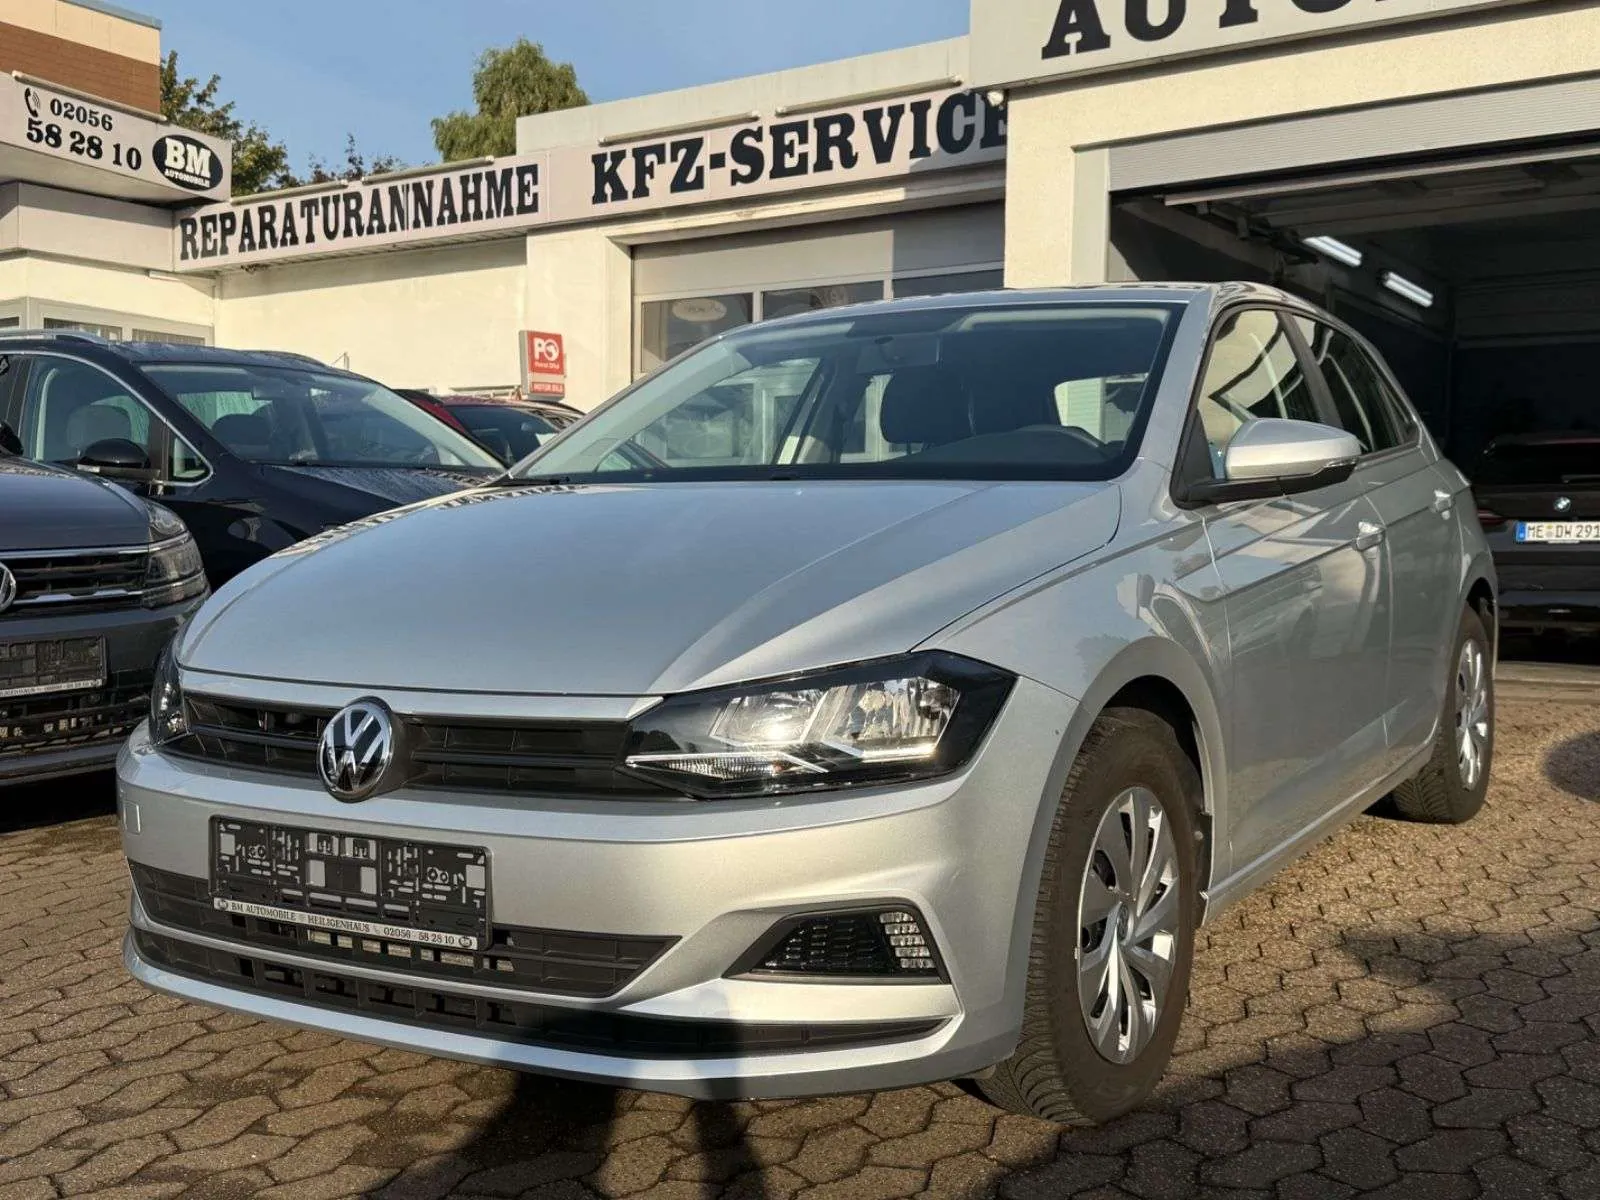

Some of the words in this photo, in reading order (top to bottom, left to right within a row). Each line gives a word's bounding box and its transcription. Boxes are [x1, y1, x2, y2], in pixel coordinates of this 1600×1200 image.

[50, 98, 113, 132] 02056
[26, 117, 62, 148] 58
[69, 130, 103, 160] 28
[112, 142, 142, 171] 10
[164, 137, 211, 178] BM
[591, 91, 1007, 205] KFZ-SERVICE
[180, 163, 540, 261] REPARATURANNAHME
[1527, 524, 1545, 538] ME
[1555, 524, 1572, 538] DW
[231, 902, 244, 913] BM
[246, 904, 297, 921] AUTOMOBILE
[307, 914, 370, 933] HEILIGENHAUS
[383, 926, 411, 939] 02056
[444, 935, 455, 945] 10
